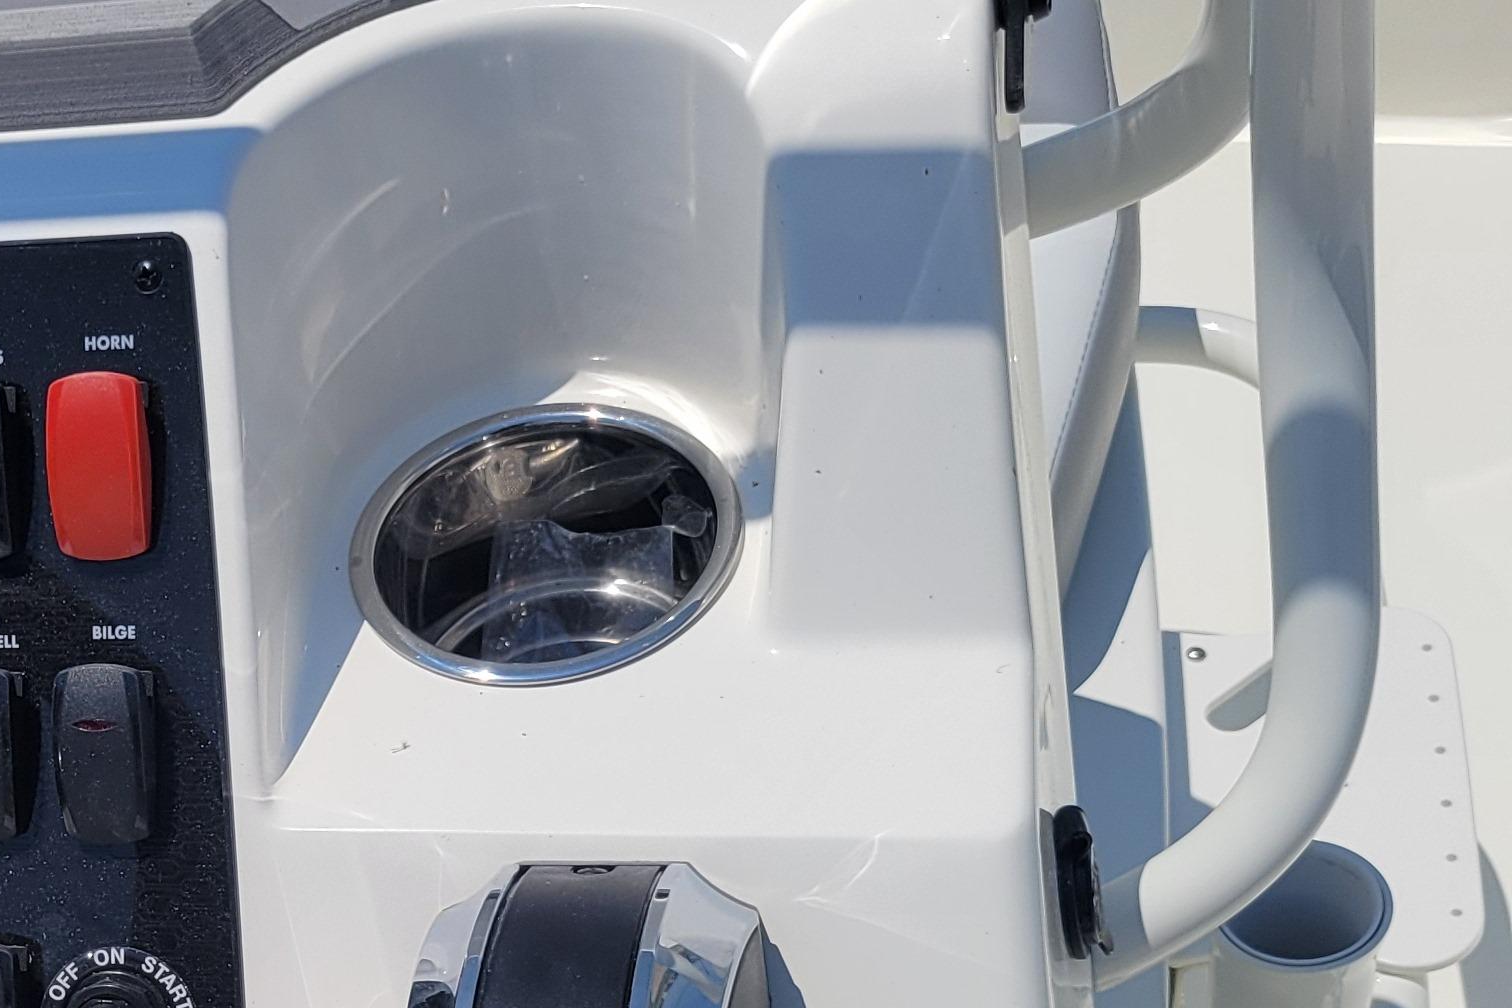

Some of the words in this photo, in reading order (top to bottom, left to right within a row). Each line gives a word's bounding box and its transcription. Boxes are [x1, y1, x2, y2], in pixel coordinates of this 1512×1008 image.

[84, 334, 134, 351] HORN
[92, 625, 136, 640] BILGE
[49, 962, 79, 1001] OFF
[93, 947, 125, 966] ON
